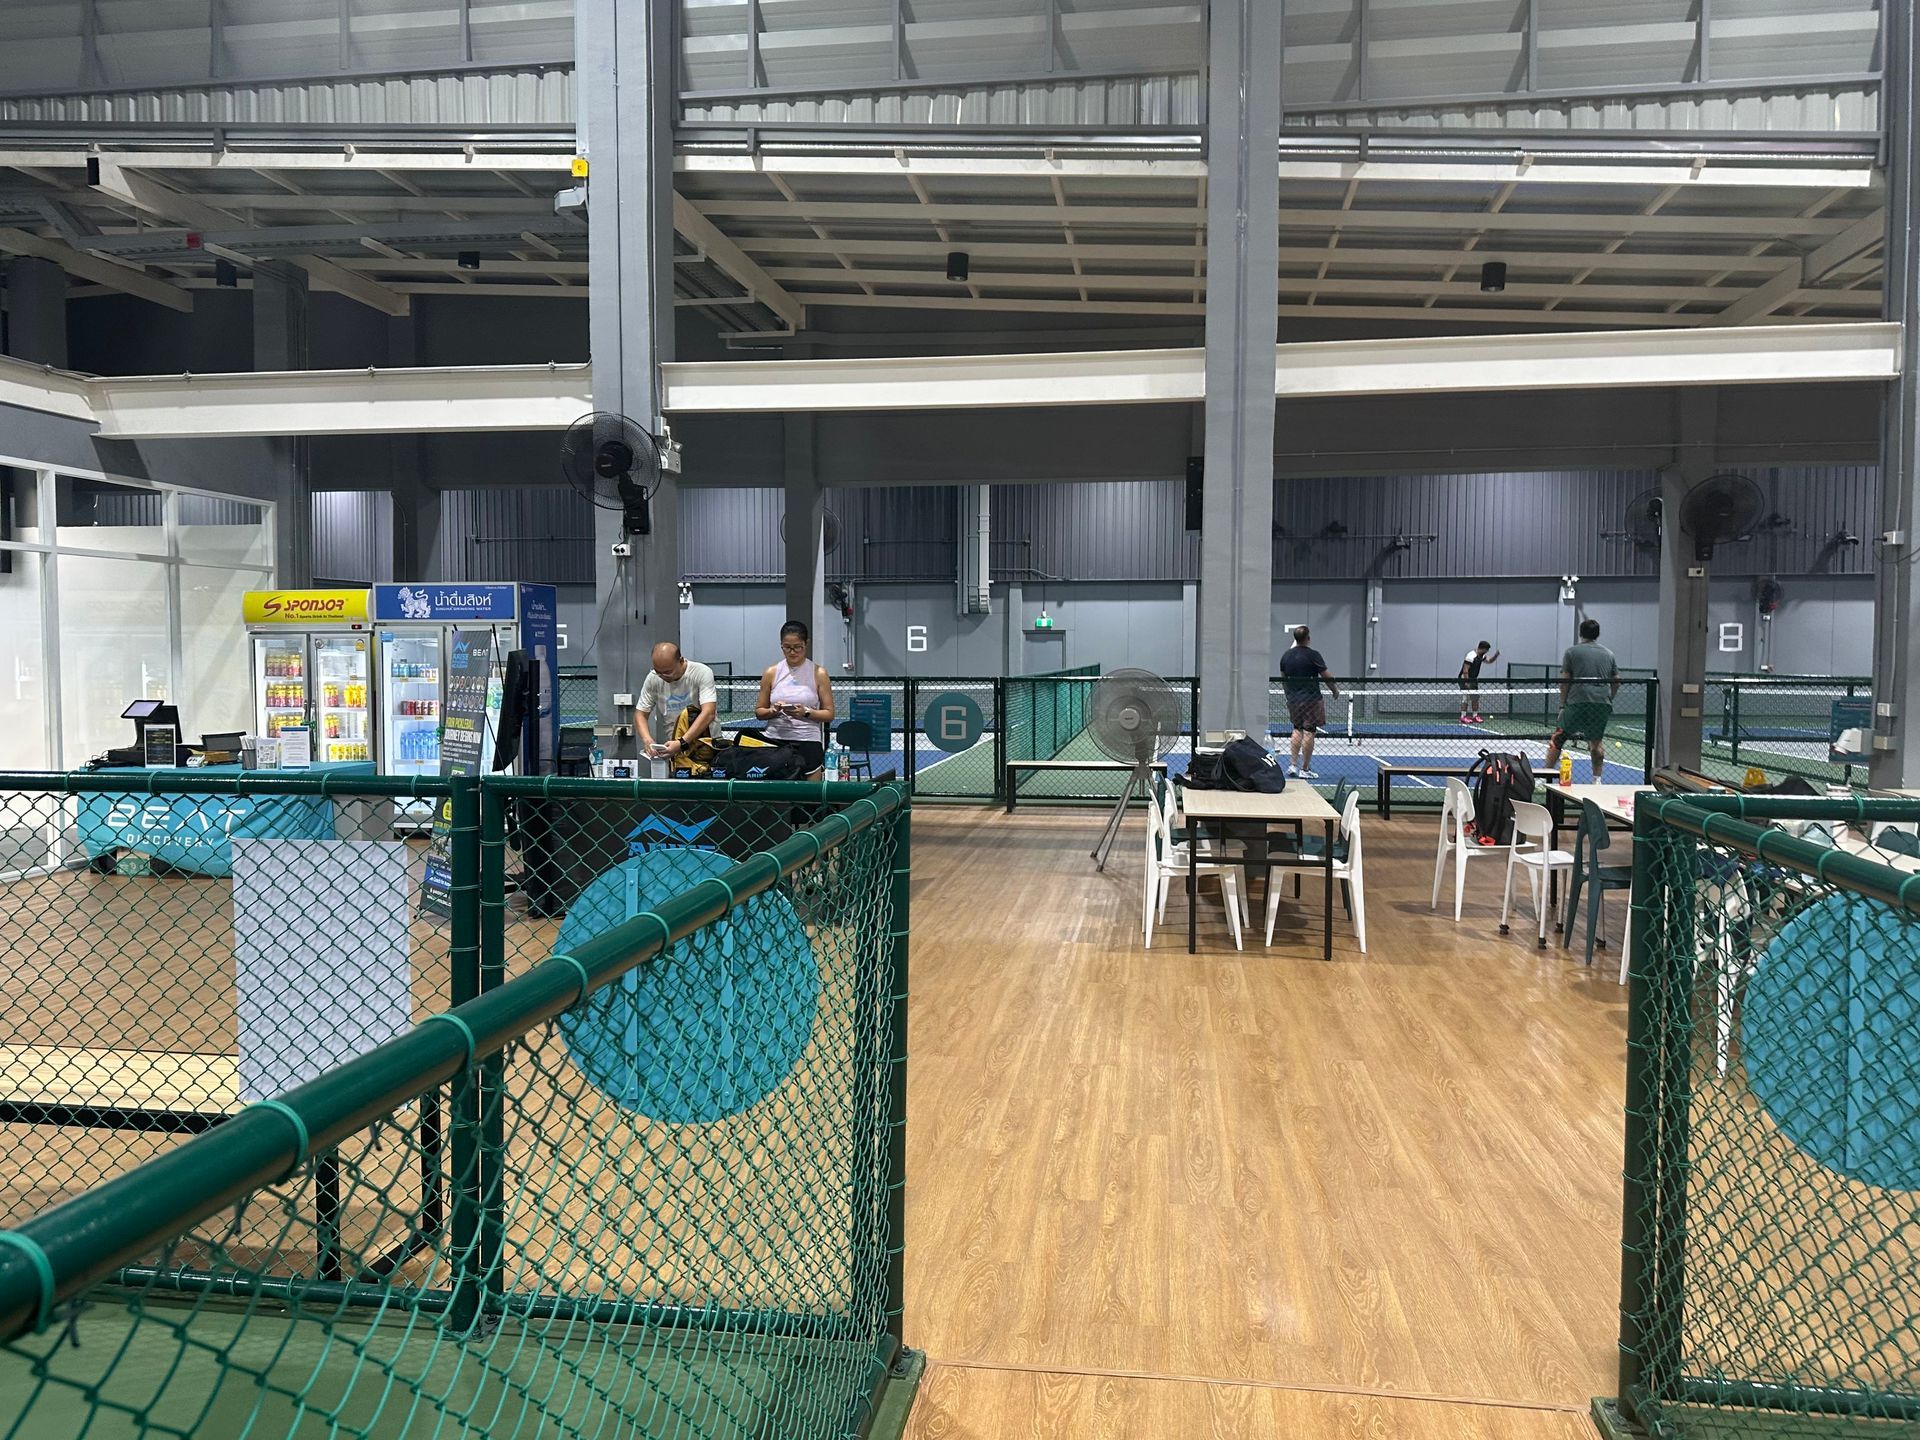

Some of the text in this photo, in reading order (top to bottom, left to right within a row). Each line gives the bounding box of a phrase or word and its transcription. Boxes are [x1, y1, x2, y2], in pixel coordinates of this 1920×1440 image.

[284, 599, 345, 611] SPONSOR
[435, 590, 492, 606] น้ำดื่มสิงห์
[907, 625, 927, 652] 6
[1718, 622, 1743, 652] 8
[941, 705, 967, 740] 6
[107, 803, 246, 832] BEAT
[126, 833, 215, 847] DISCOVERY
